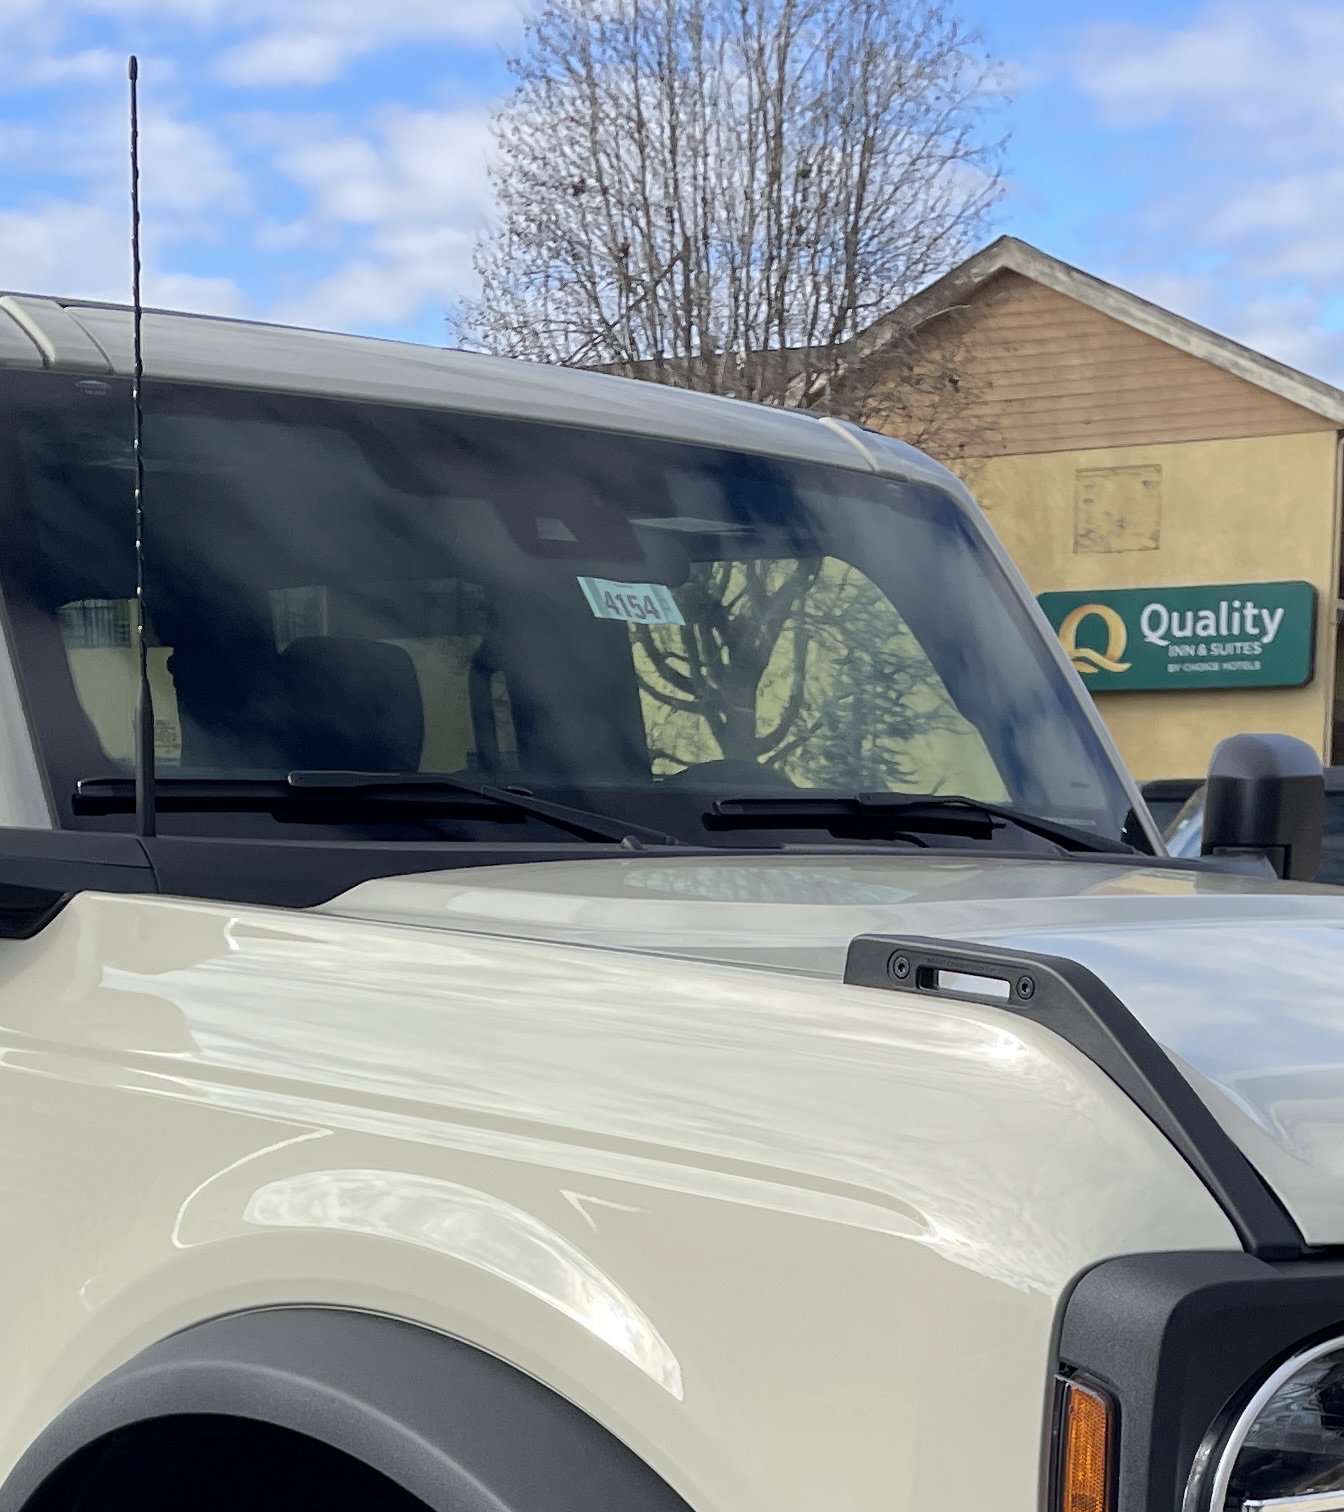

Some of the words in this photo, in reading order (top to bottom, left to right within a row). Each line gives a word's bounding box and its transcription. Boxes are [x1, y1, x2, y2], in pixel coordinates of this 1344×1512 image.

[604, 590, 661, 620] 4154
[1140, 600, 1285, 645] Quality
[1168, 645, 1195, 657] INN
[1197, 644, 1207, 656] &
[1210, 641, 1263, 655] SUITES
